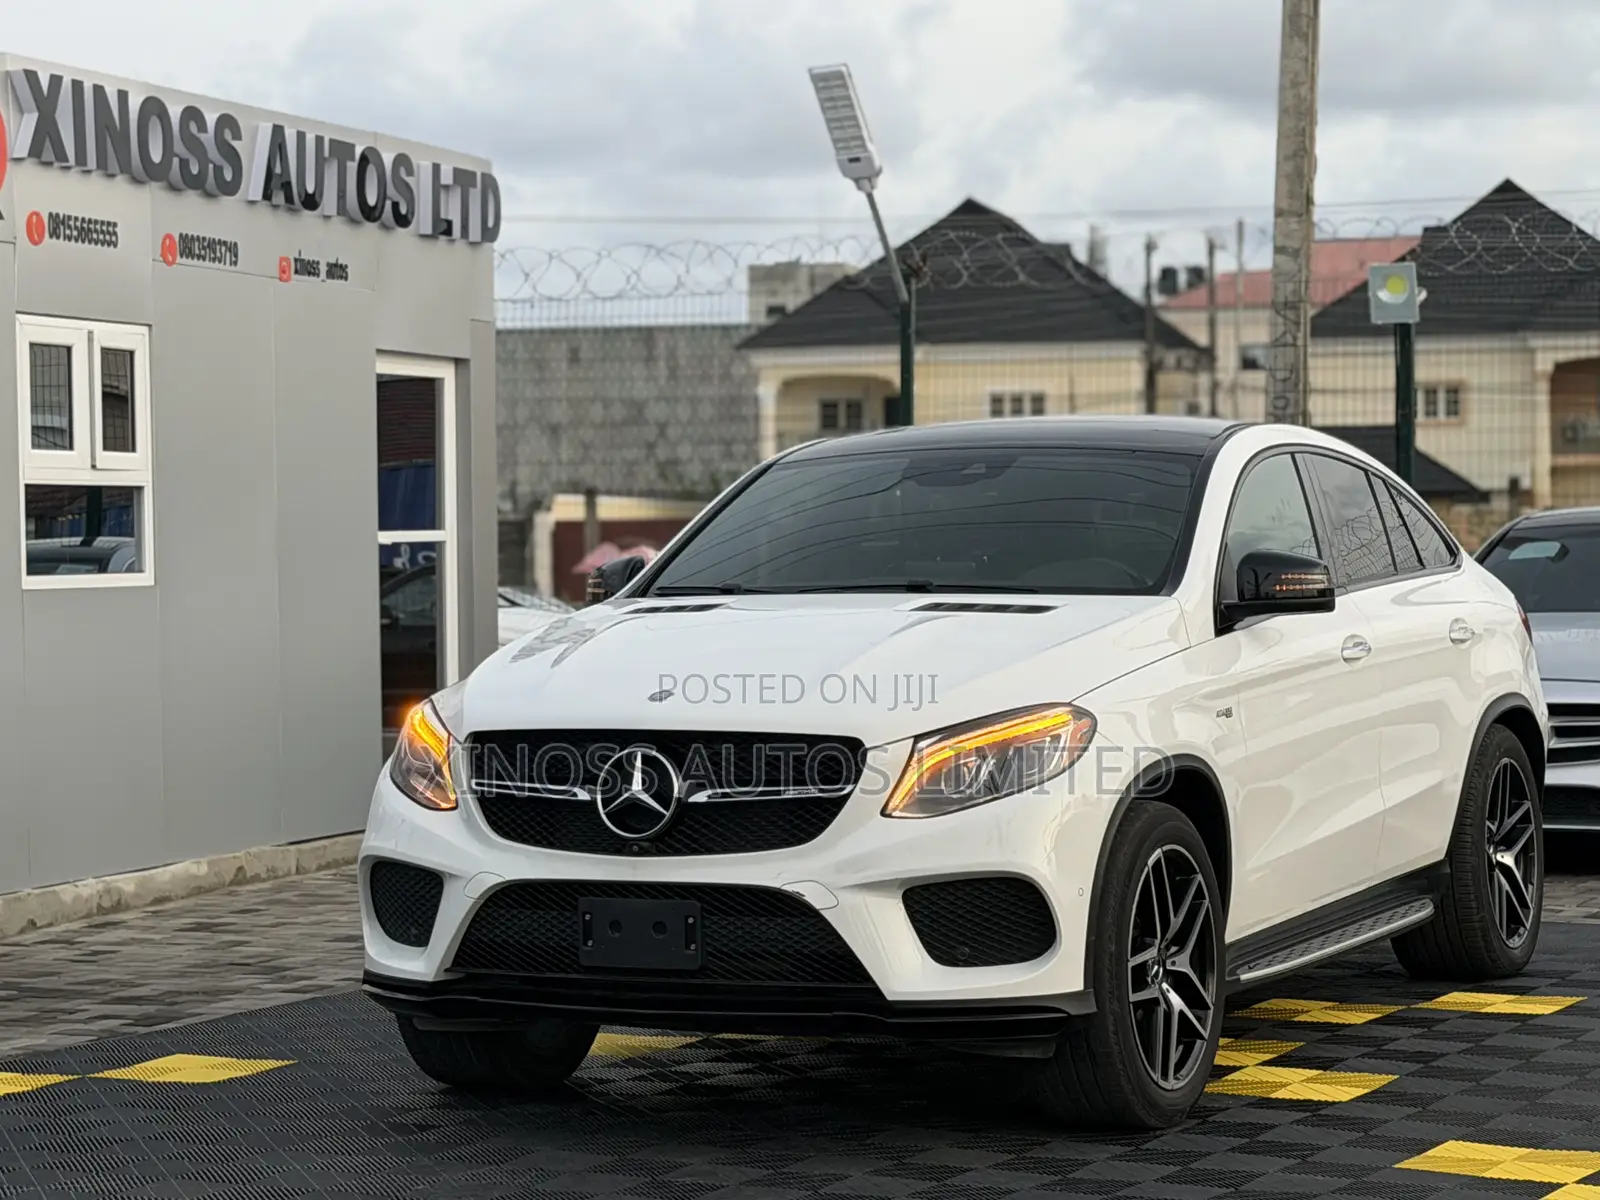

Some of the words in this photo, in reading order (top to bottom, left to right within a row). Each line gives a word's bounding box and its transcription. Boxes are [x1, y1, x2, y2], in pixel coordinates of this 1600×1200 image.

[20, 68, 243, 197] XINOSS
[258, 122, 416, 229] AUTOS
[427, 162, 502, 243] LTD
[47, 211, 119, 249] 08155665555
